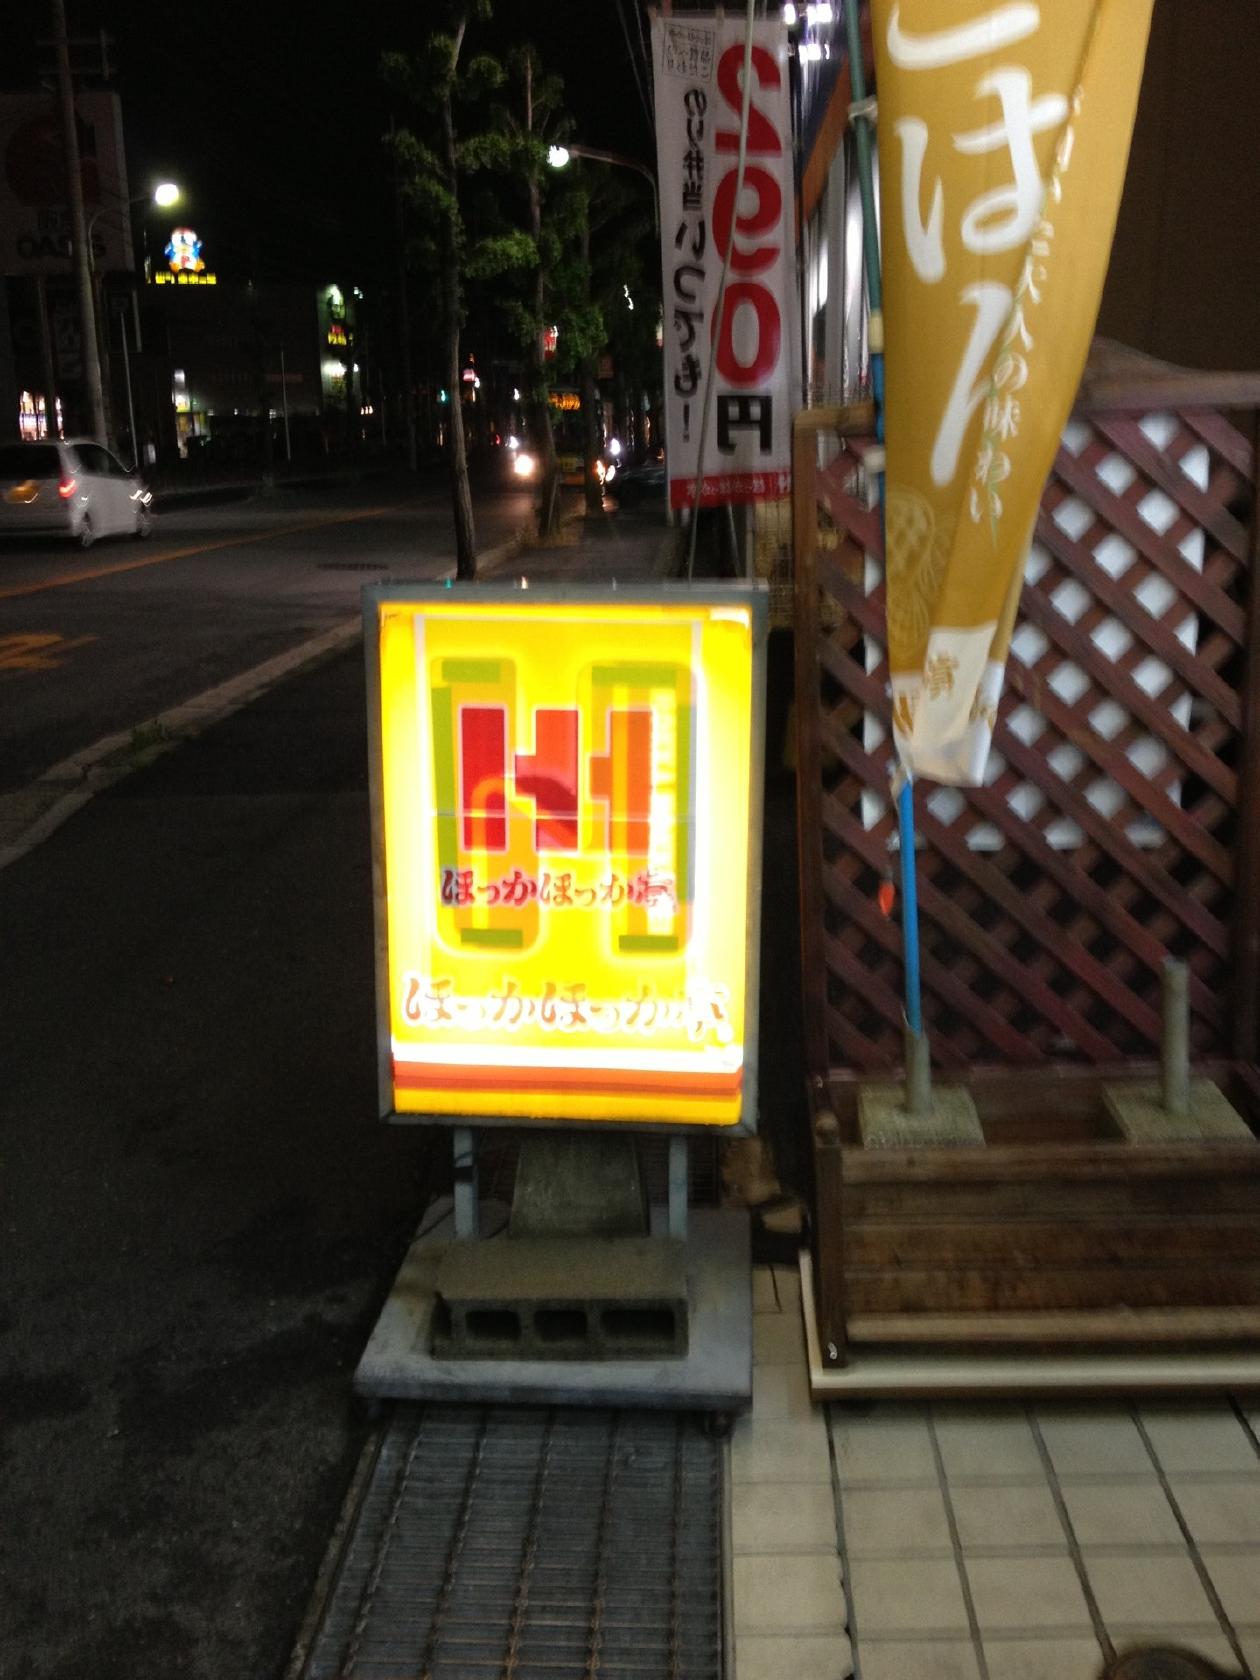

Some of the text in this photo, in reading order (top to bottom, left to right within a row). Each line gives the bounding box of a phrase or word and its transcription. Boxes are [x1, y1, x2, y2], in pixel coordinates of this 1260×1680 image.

[17, 234, 107, 258] OASS
[404, 976, 730, 1036] ほっかほっか
